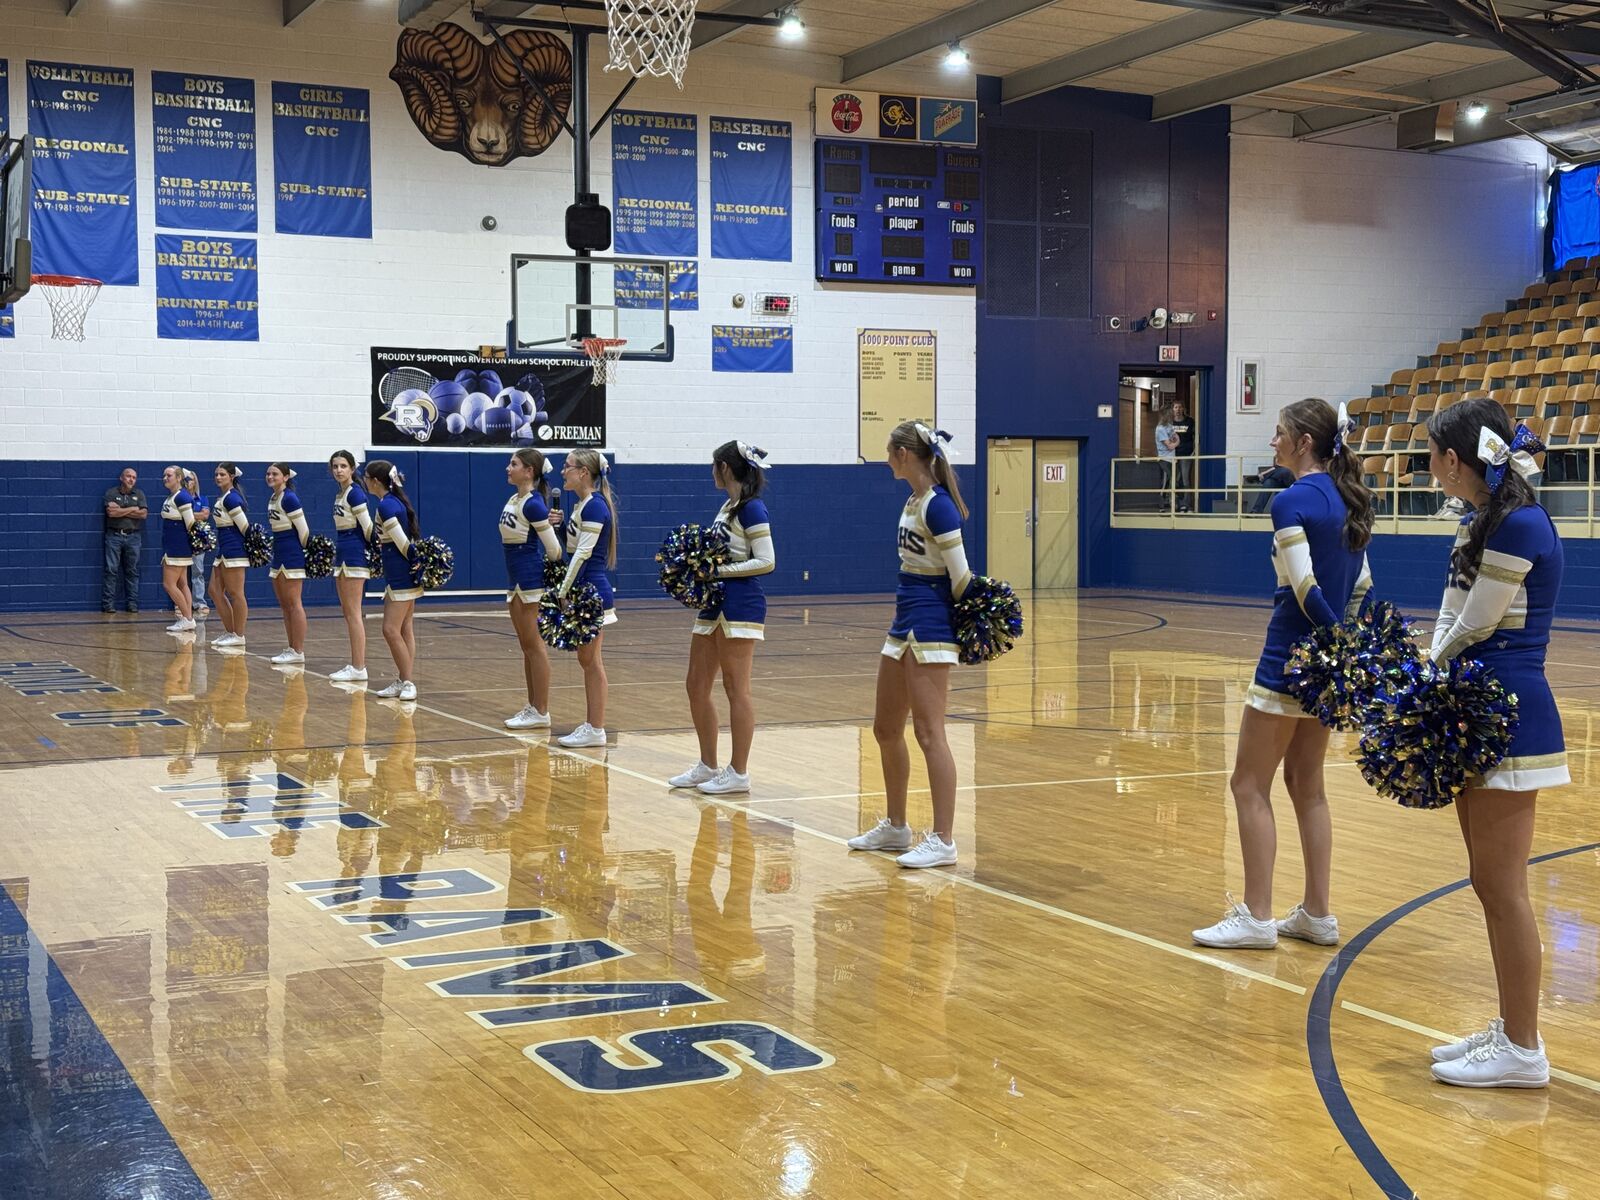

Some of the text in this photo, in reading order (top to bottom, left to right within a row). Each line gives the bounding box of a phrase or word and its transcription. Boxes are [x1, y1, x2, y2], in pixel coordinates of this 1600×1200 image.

[28, 65, 132, 87] VOLLEYBALL
[184, 78, 224, 94] BOYS
[62, 90, 99, 102] CNC
[154, 92, 253, 113] BASKETBALL
[300, 88, 343, 103] GIRLS
[274, 102, 368, 122] BASKETBALL
[187, 116, 222, 128] CNC
[613, 113, 695, 131] SOFTBALL
[712, 120, 790, 138] BASEBALL
[305, 125, 339, 137] CNC
[35, 137, 128, 154] REGIONAL
[640, 134, 670, 146] CNC
[738, 141, 766, 152] CNC
[830, 146, 856, 160] Rams
[947, 153, 979, 168] Guests
[160, 176, 252, 192] SUB-STATE
[280, 182, 366, 198] SUB-STATE
[35, 189, 129, 206] SUB-STATE
[619, 197, 693, 211] REGIONAL
[888, 195, 919, 208] period
[716, 203, 787, 216] REGIONAL
[831, 214, 855, 228] fouls
[889, 217, 918, 230] player
[951, 220, 974, 234] fouls
[182, 240, 233, 255] BOYS
[157, 253, 256, 270] BASKETBALL
[835, 262, 853, 273] won
[182, 270, 234, 282] STATE
[892, 263, 916, 276] game
[954, 267, 971, 277] won
[157, 298, 258, 311] RUNNER-UP
[223, 320, 244, 330] PLACE
[713, 326, 792, 340] BASEBALL
[732, 338, 774, 348] STATE
[863, 335, 933, 346] 1000 POINT CLUB
[377, 352, 415, 361] PROUDLY
[416, 353, 467, 363] SUPPORTING
[530, 358, 560, 366] SCHOOL
[1161, 347, 1176, 360] EXIT
[553, 425, 602, 440] FREEMAN
[1045, 465, 1064, 481] EXIT
[151, 771, 391, 841] THE
[285, 867, 836, 1094] RAMS
